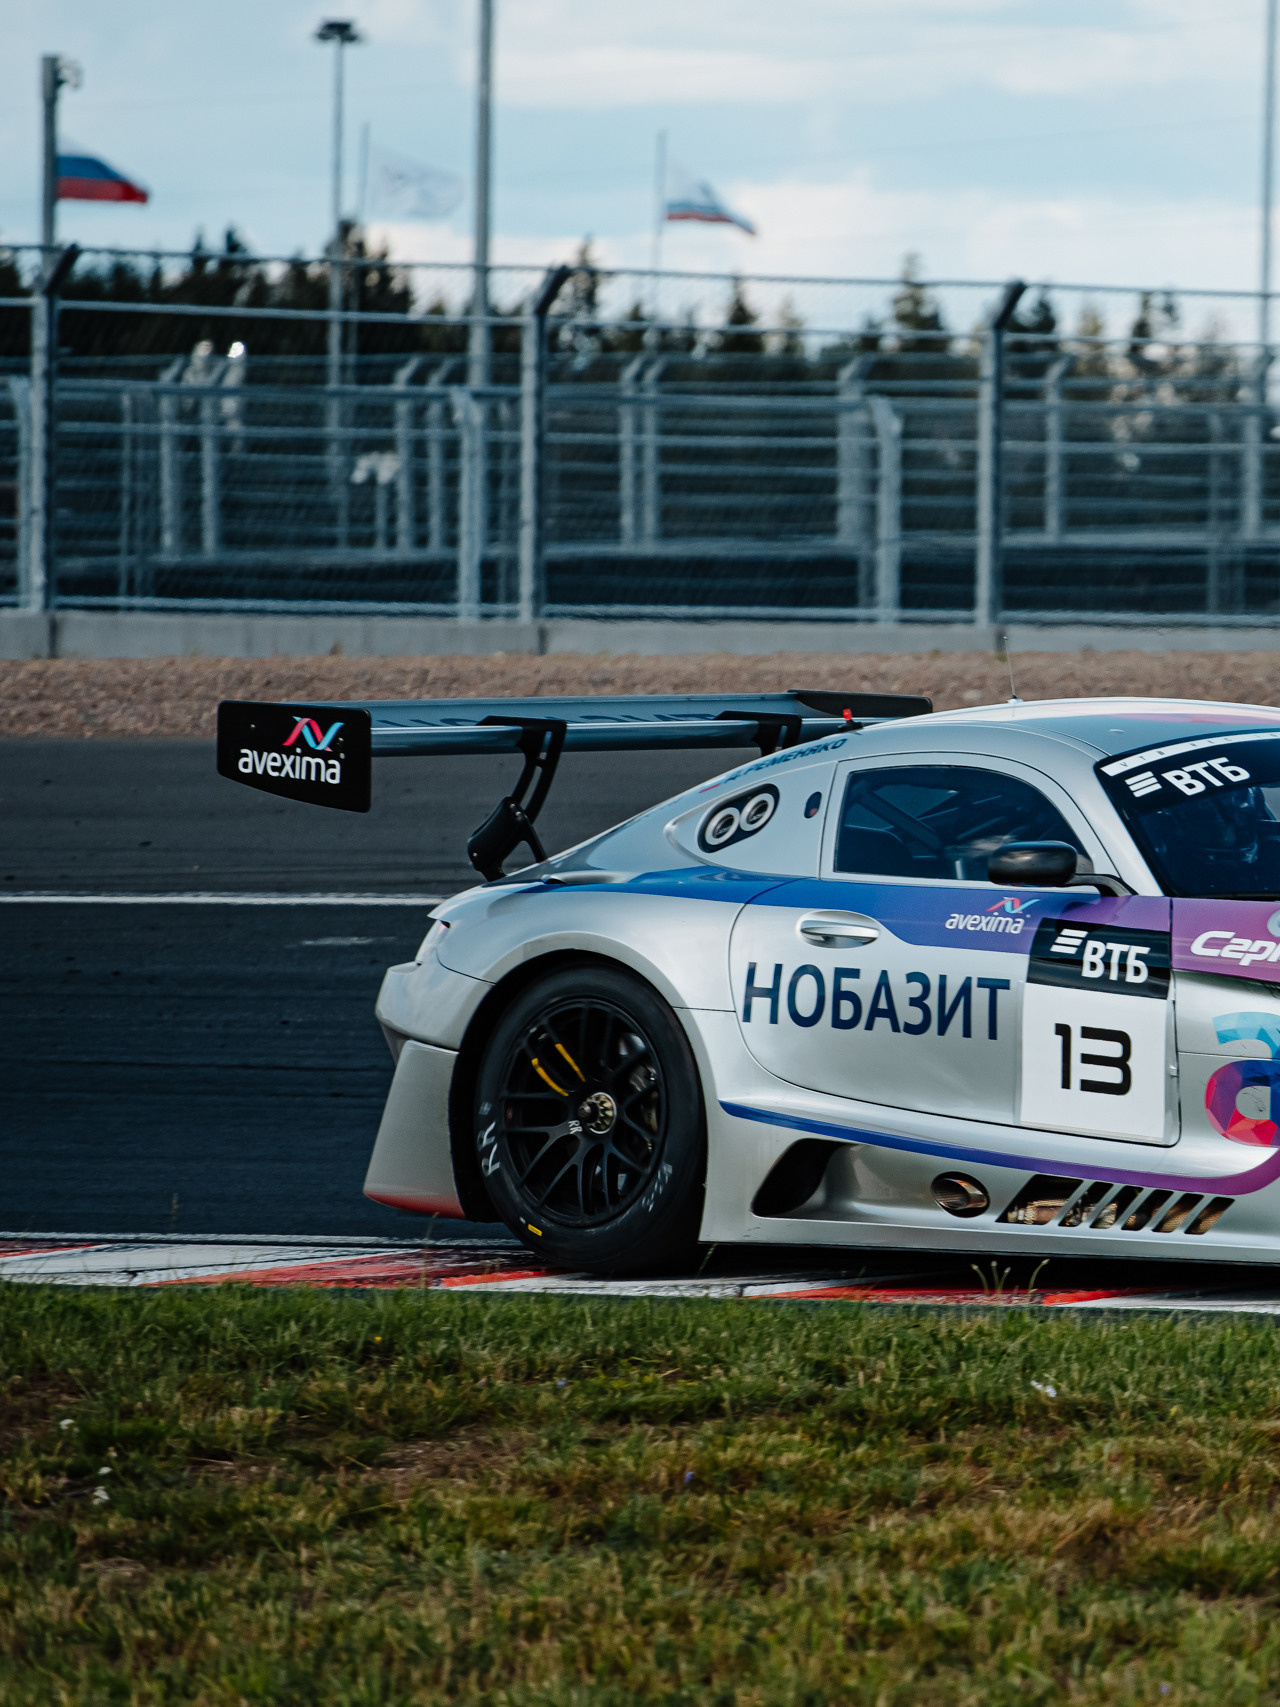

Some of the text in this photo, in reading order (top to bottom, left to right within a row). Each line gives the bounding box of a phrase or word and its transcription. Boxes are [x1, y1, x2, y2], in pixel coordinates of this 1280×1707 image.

[238, 748, 342, 784] avexima
[1161, 757, 1251, 796] ВТБ
[945, 912, 1025, 934] avexima
[1082, 940, 1150, 983] ВТБ
[742, 961, 1010, 1040] НОБАЗИТ
[1055, 1023, 1131, 1096] 13
